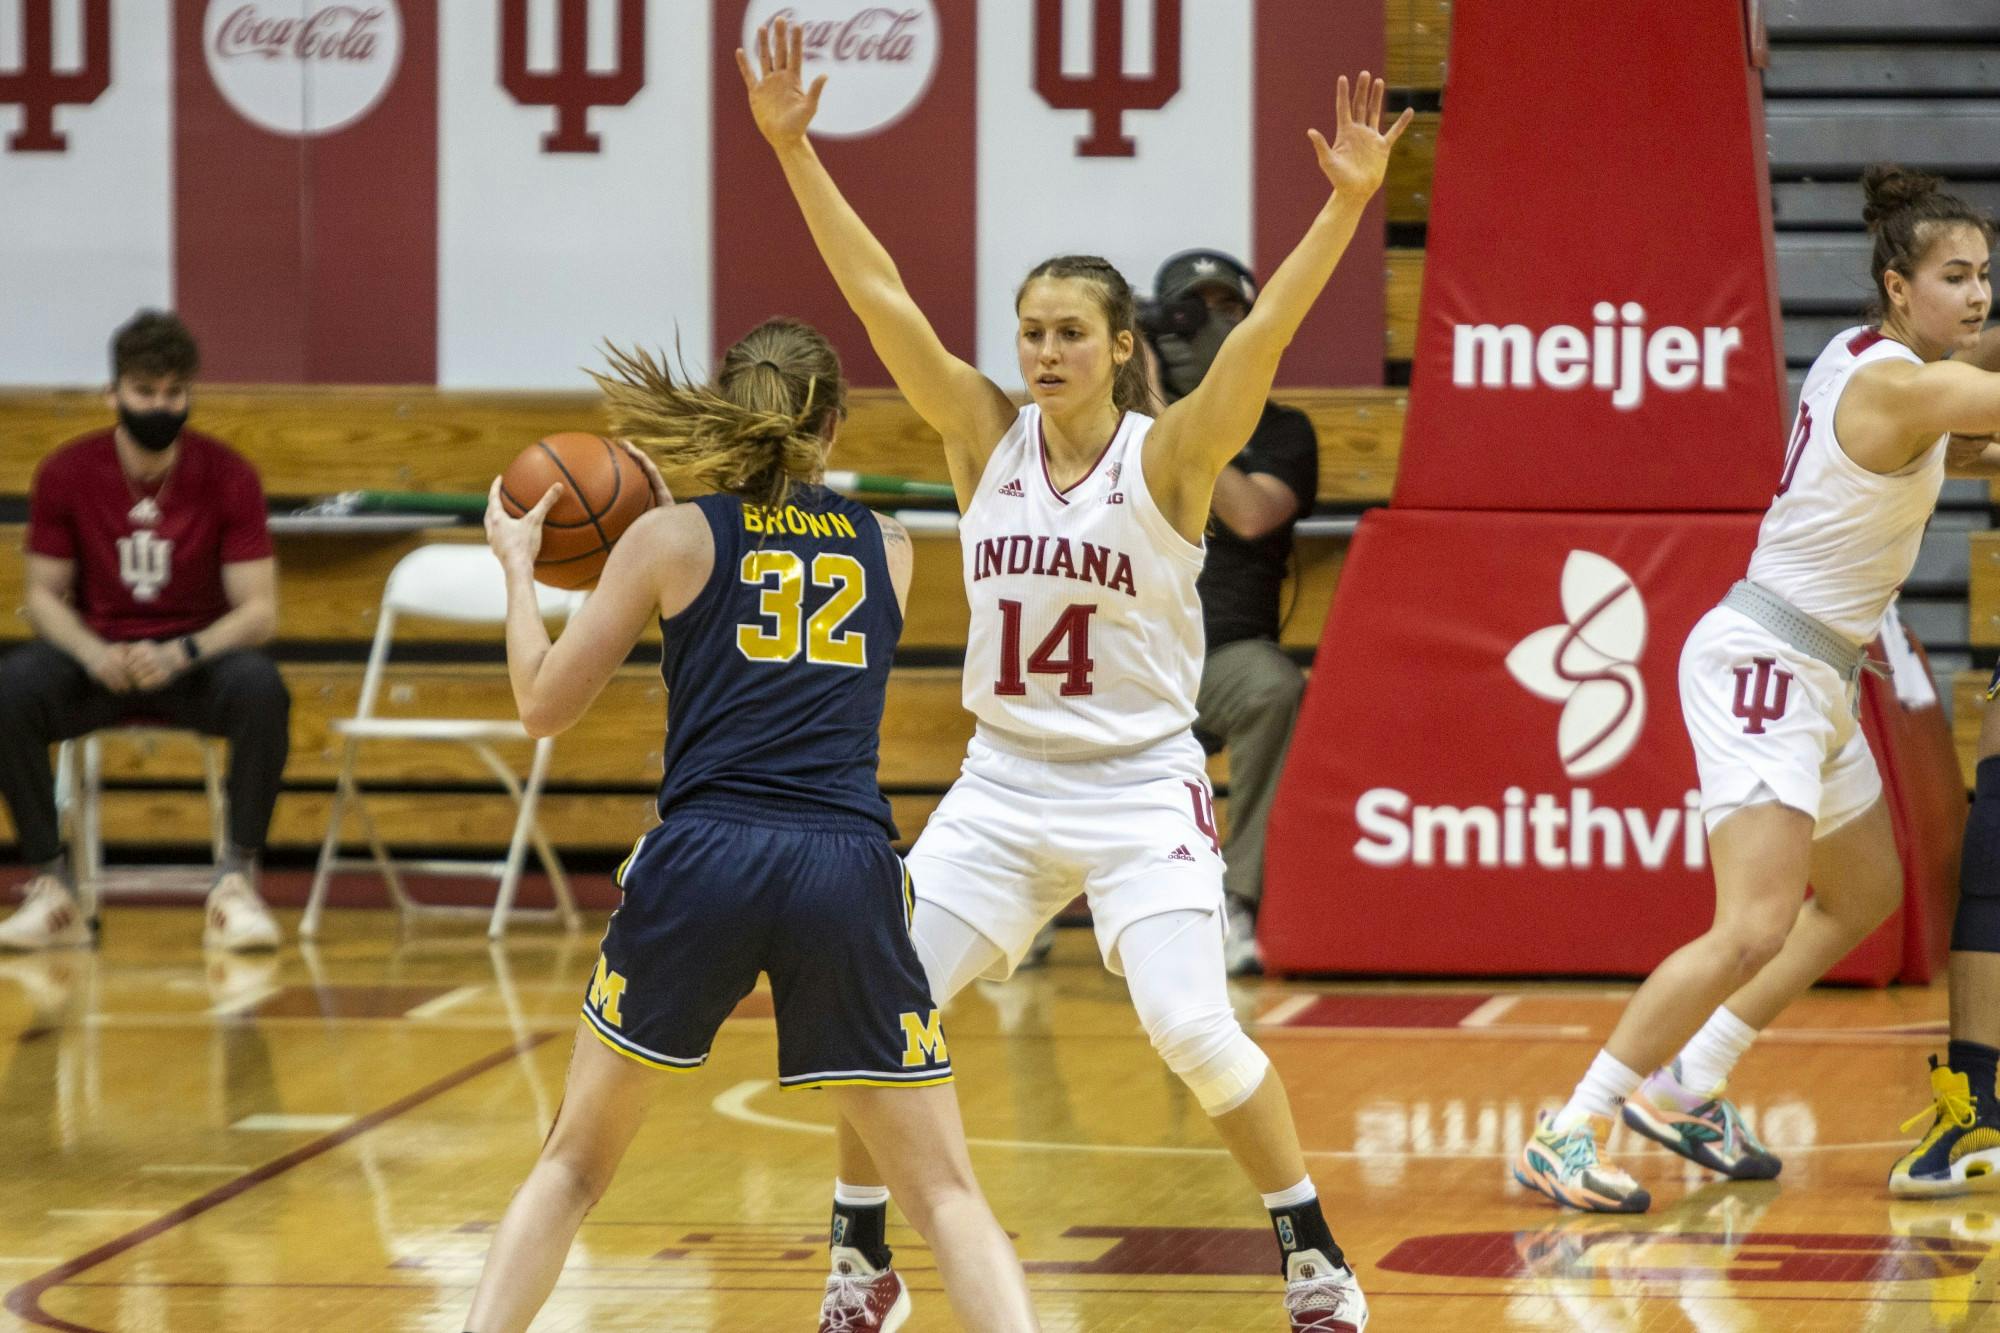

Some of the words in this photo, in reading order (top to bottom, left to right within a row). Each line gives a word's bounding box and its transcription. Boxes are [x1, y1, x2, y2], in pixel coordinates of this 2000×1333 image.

[1452, 301, 1742, 411] meijer
[742, 503, 857, 538] BROWN
[974, 534, 1137, 598] INDIANA
[737, 550, 868, 668] 32
[994, 598, 1098, 696] 14
[1353, 786, 1704, 867] Smithvi
[588, 951, 627, 1028] M
[899, 1008, 948, 1067] M
